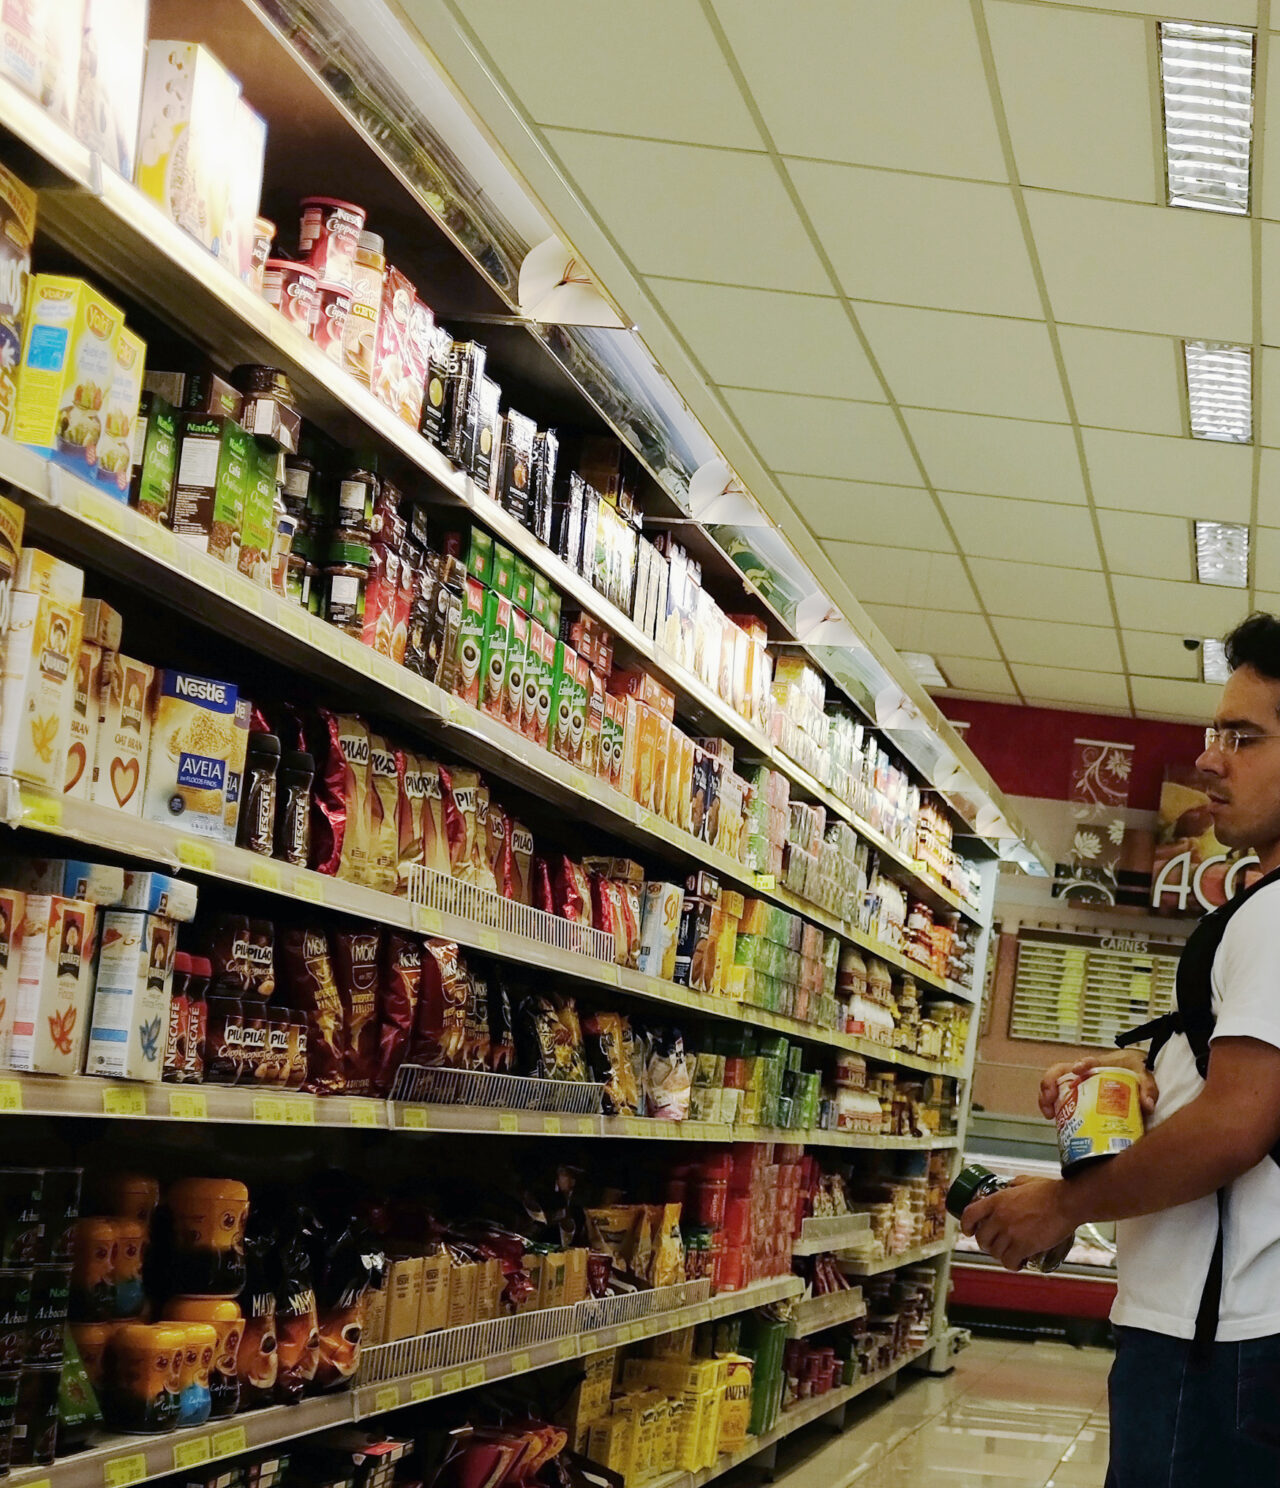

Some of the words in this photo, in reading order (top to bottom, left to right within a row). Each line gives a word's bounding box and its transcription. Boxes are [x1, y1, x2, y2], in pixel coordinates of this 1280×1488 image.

[187, 420, 220, 434] Native
[176, 675, 226, 704] Nestlé
[181, 757, 222, 780] AVEIA
[257, 783, 272, 845] NESCAFÉ
[1100, 937, 1148, 953] CARNES
